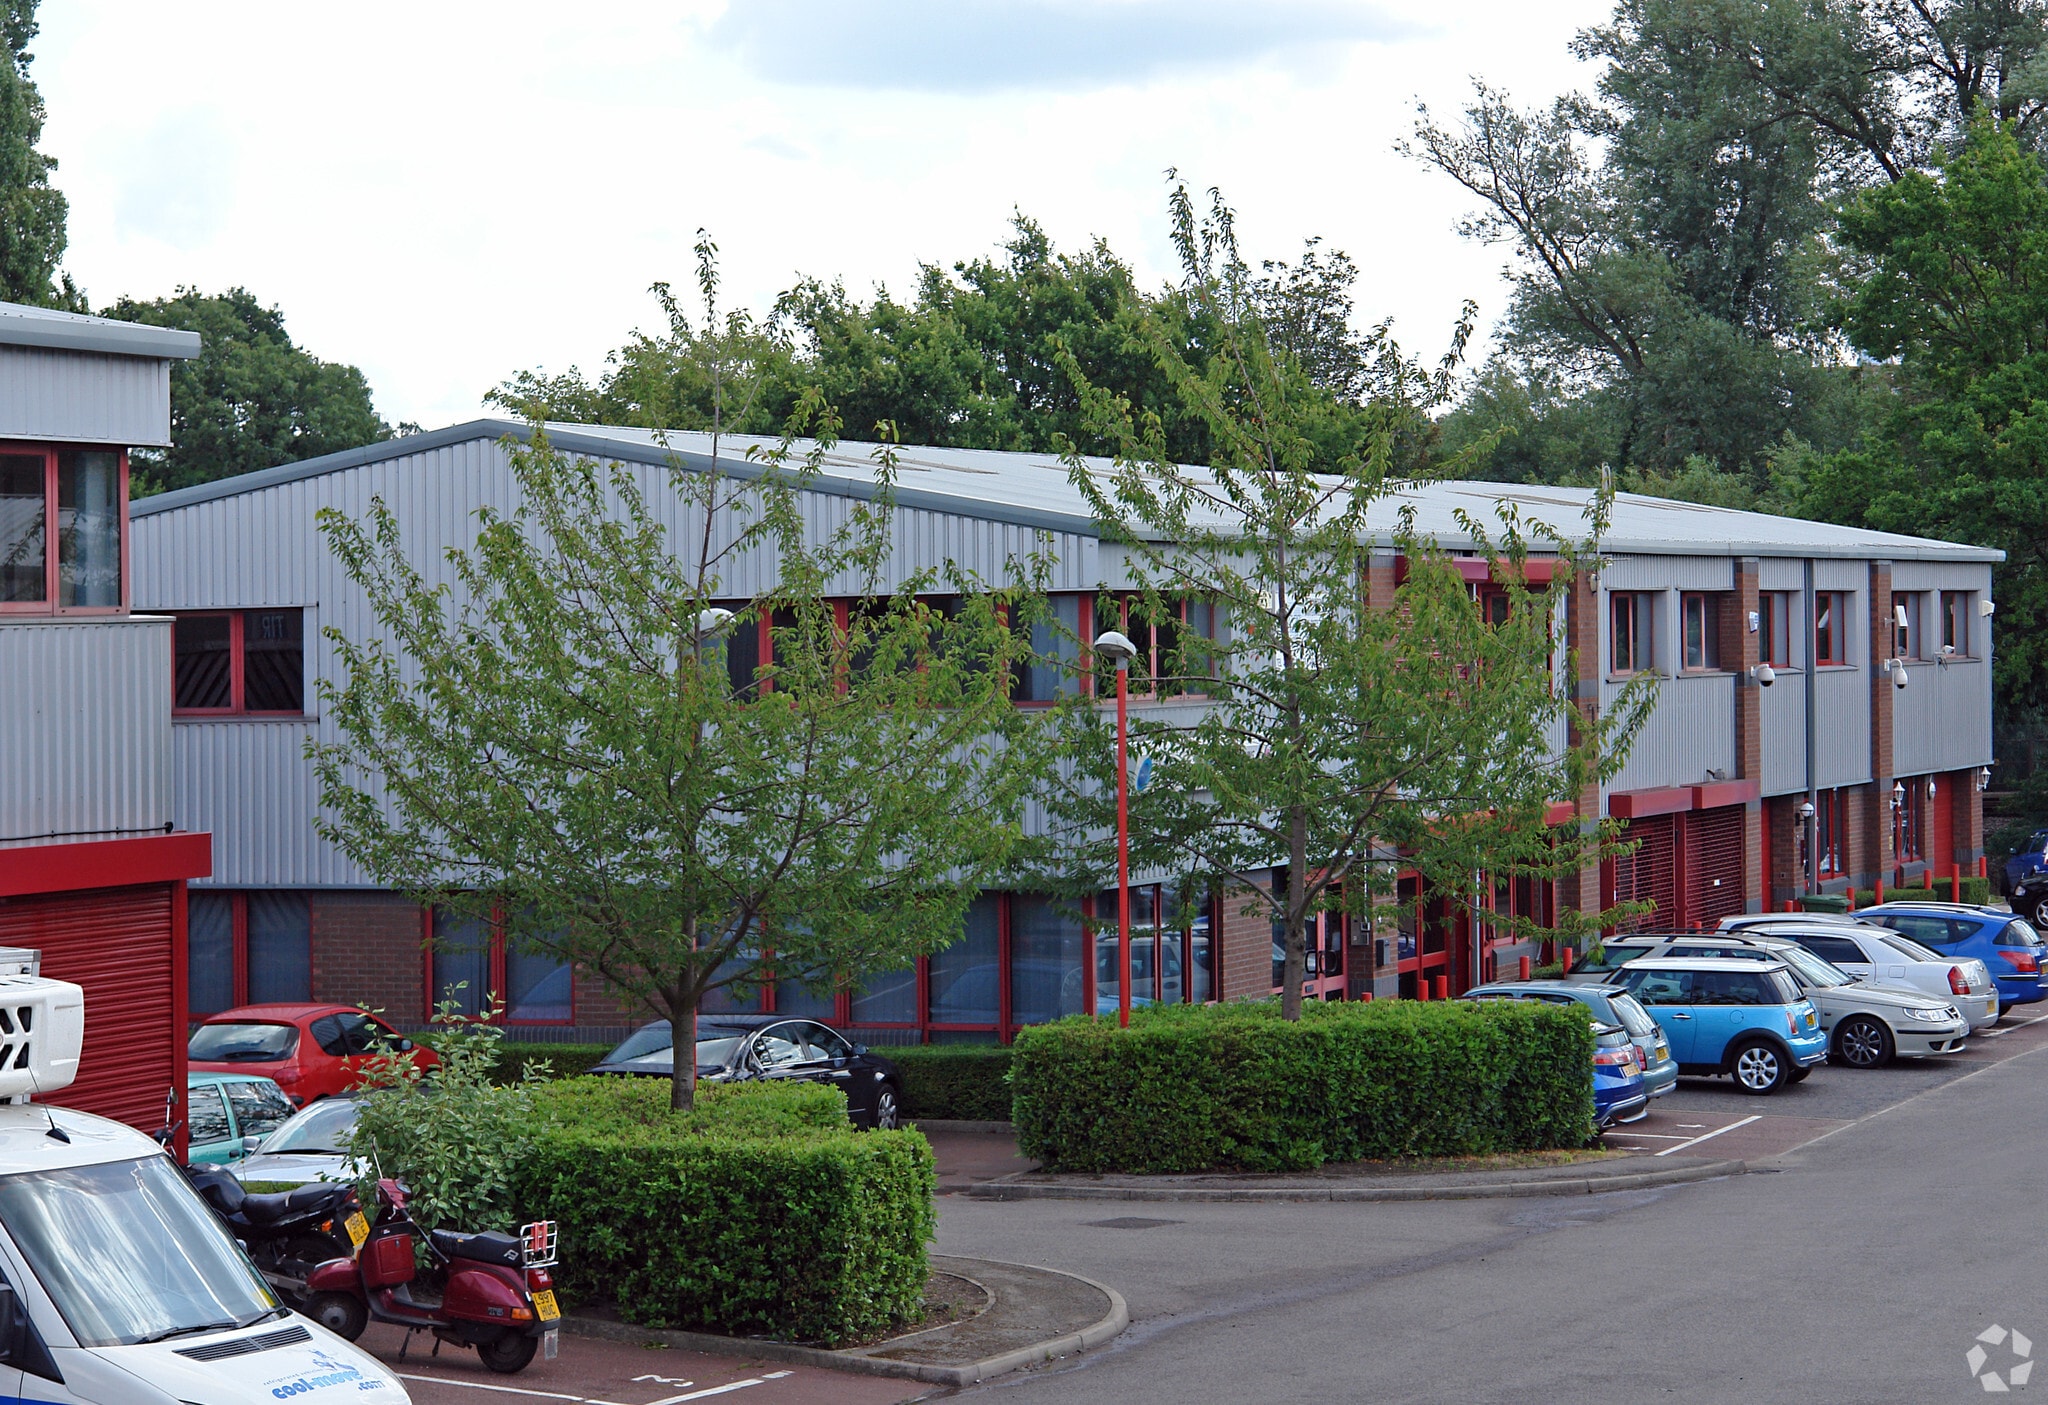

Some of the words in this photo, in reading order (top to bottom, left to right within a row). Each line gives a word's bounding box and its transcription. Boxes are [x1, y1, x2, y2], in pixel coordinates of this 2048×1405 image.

[534, 1291, 553, 1306] L997
[541, 1304, 556, 1317] HUC
[271, 1370, 364, 1400] cool-move
[358, 1380, 386, 1392] .com
